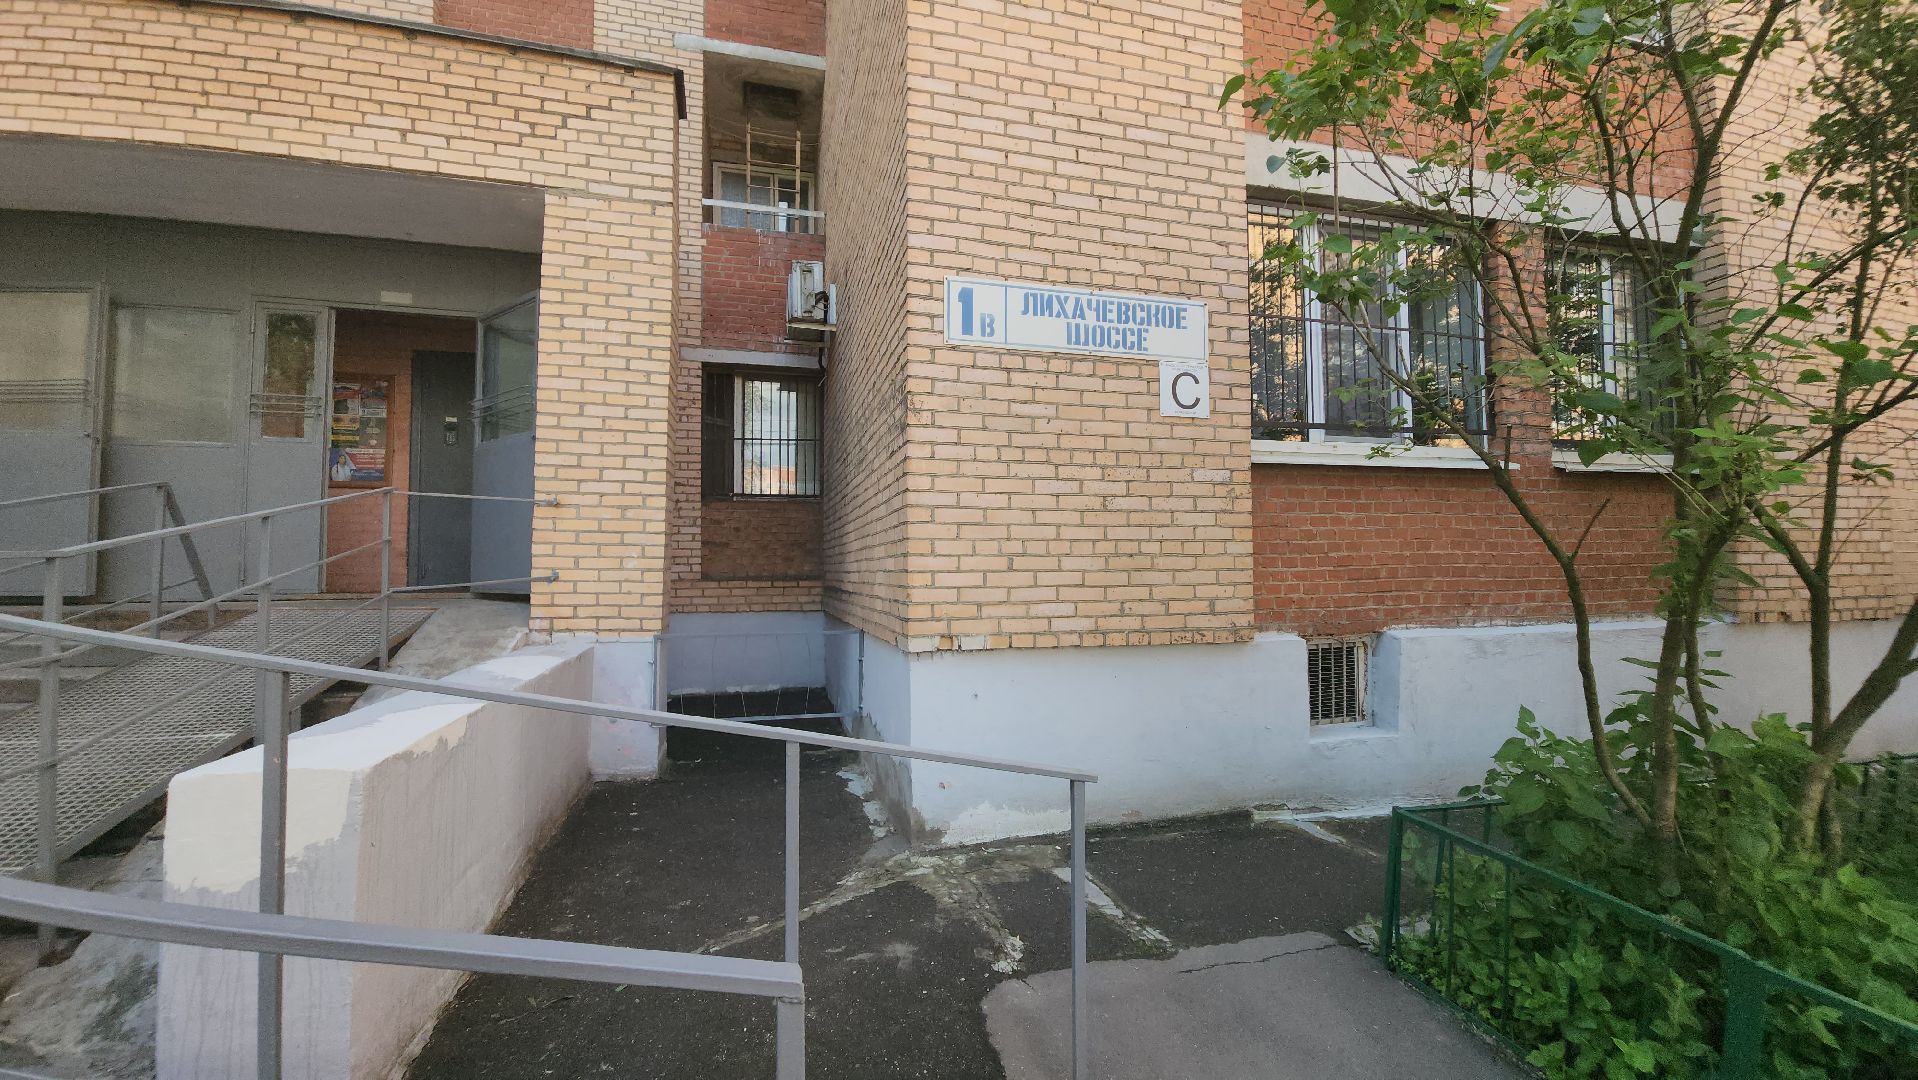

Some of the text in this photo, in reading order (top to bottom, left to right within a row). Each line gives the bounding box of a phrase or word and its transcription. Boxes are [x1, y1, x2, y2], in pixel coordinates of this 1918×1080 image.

[957, 287, 974, 336] 1
[1021, 292, 1188, 330] ЛИХАЧЕВСКОЕ
[1066, 321, 1149, 351] ШОССЕ
